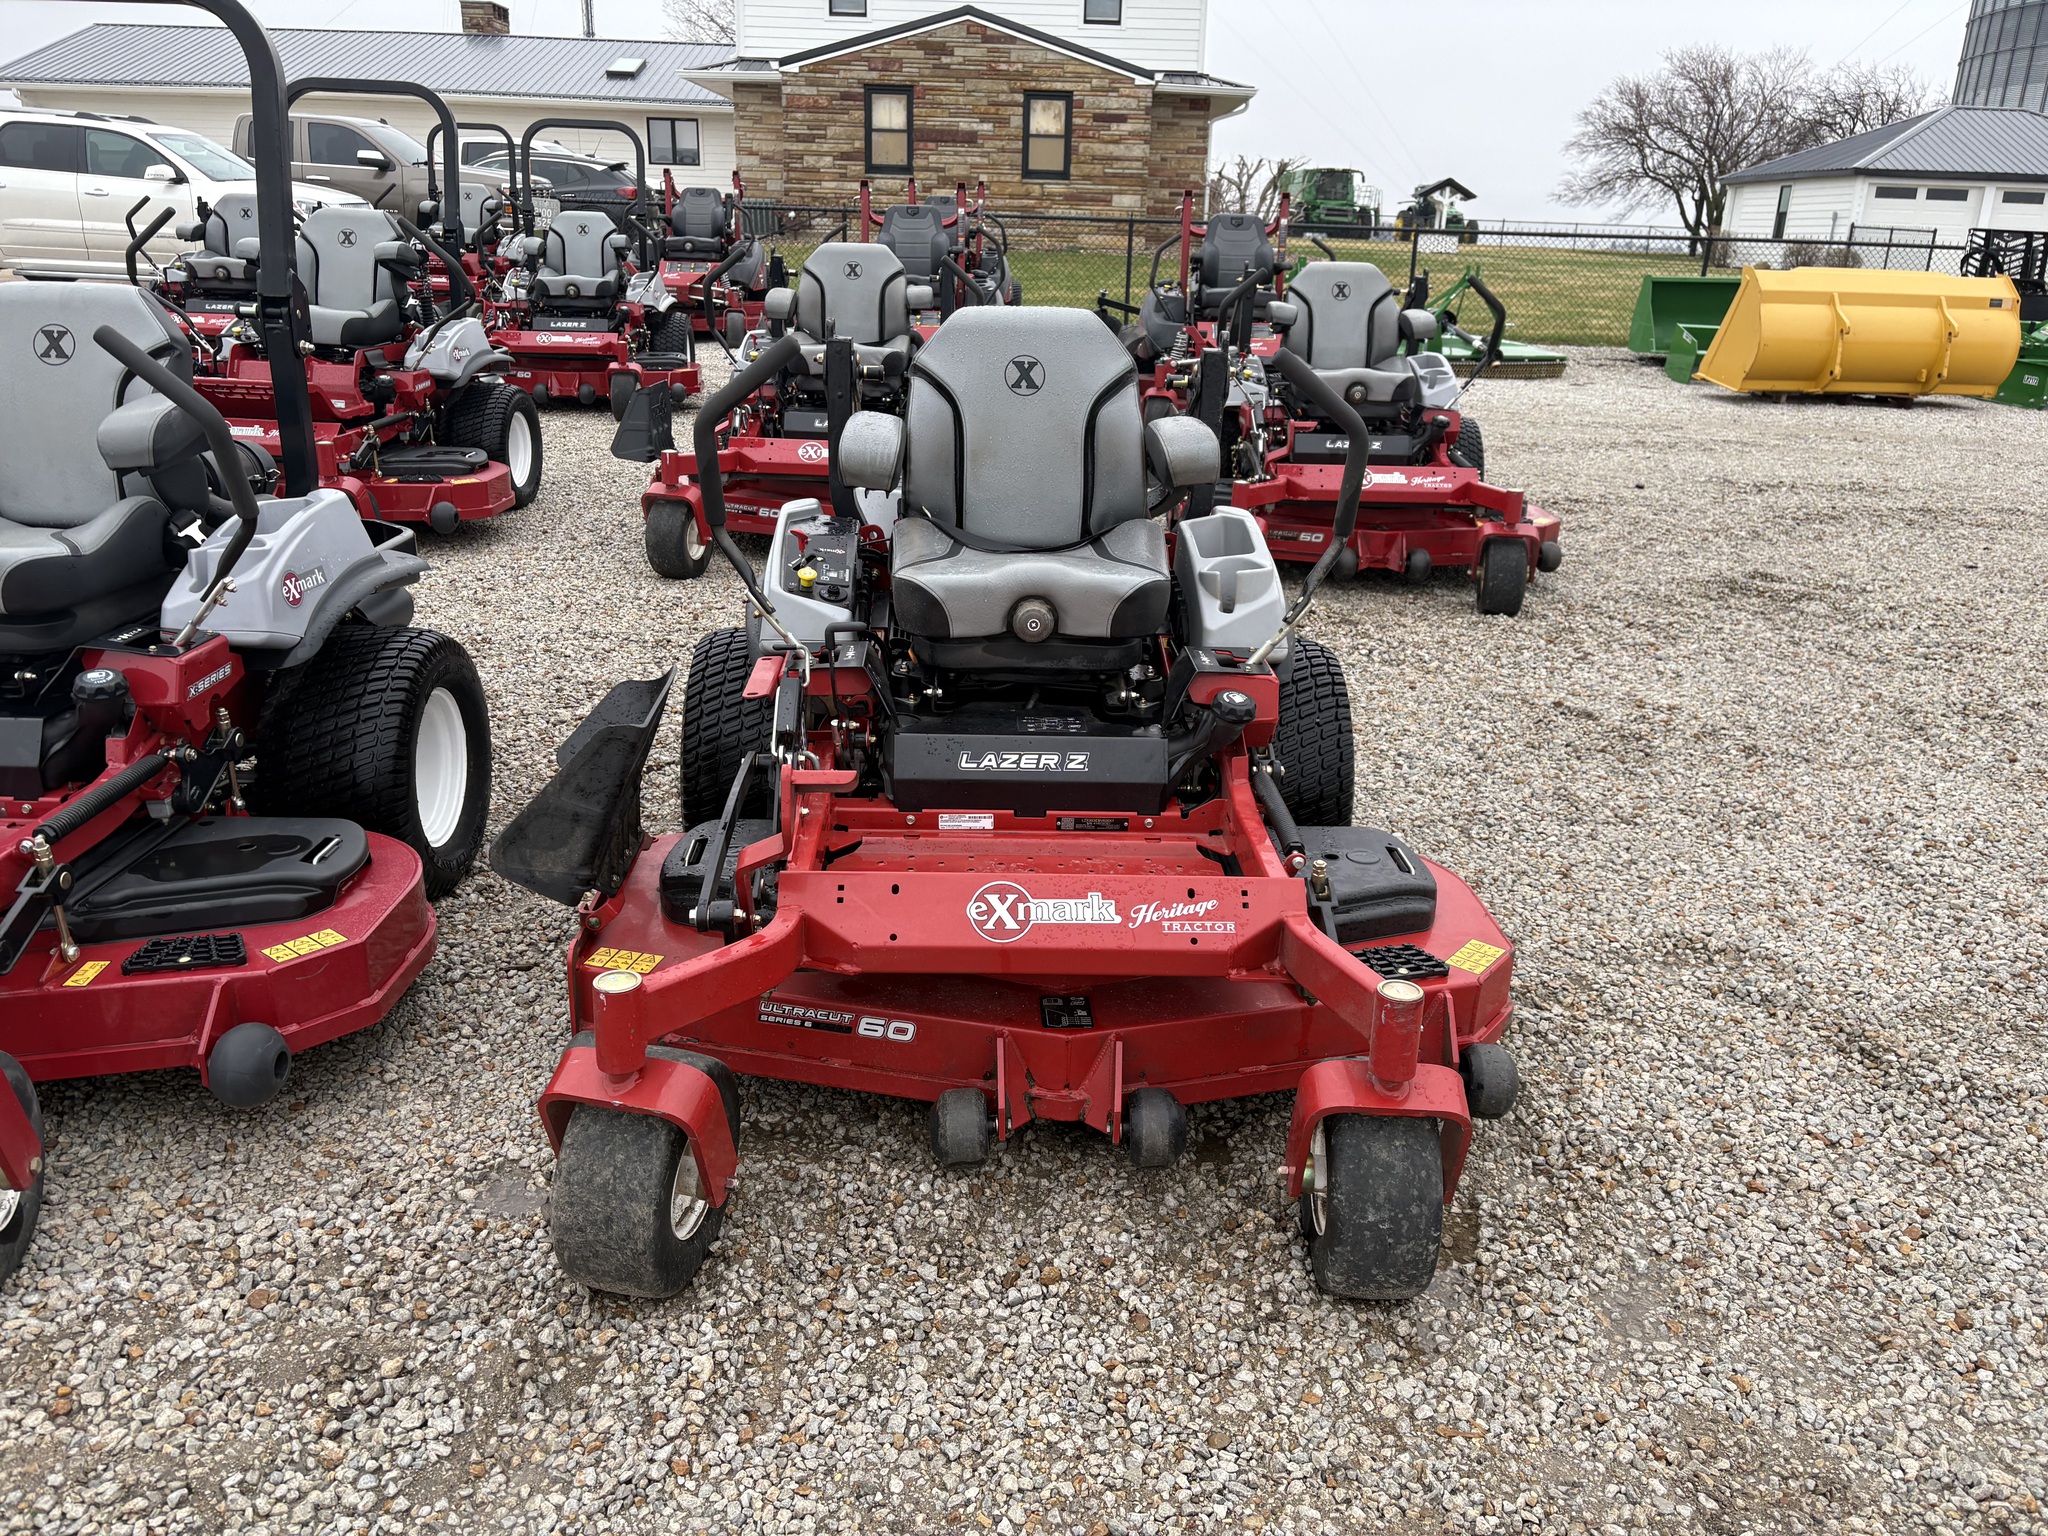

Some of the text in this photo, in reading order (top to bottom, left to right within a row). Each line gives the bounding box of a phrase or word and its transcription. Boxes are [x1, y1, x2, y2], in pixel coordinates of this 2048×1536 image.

[241, 207, 251, 219] X
[339, 230, 355, 246] X
[578, 224, 588, 235] X
[845, 262, 861, 278] X
[1334, 283, 1349, 299] X
[38, 327, 72, 361] X
[1009, 358, 1041, 392] X
[759, 507, 781, 518] 60
[1300, 532, 1324, 542] 60
[282, 569, 327, 603] eXmark
[187, 662, 232, 700] X-SERIES
[958, 751, 1089, 771] LAZER Z
[967, 890, 1122, 931] eXmark
[1128, 899, 1219, 929] Heritage
[1162, 922, 1236, 932] TRACTOR
[759, 1001, 855, 1024] ULTRACUT
[760, 1013, 802, 1026] SERIES
[856, 1016, 917, 1043] 60
